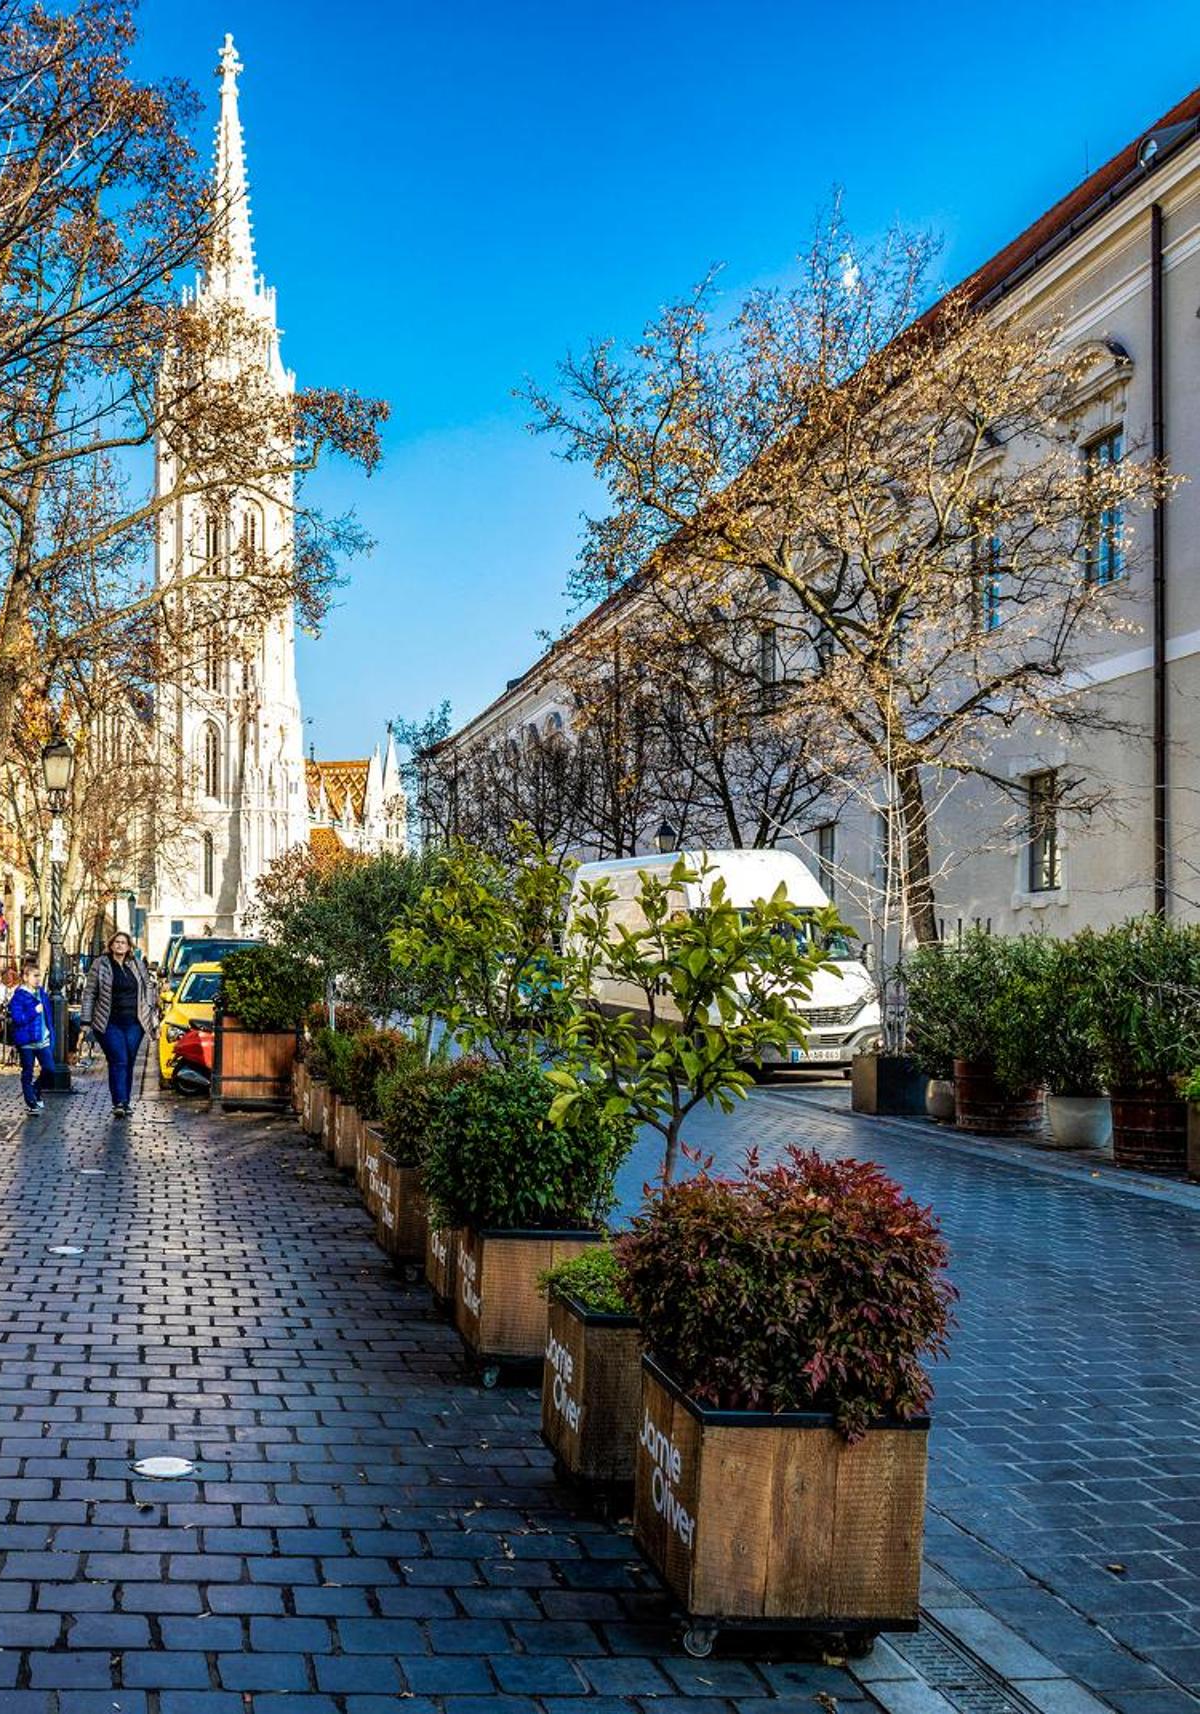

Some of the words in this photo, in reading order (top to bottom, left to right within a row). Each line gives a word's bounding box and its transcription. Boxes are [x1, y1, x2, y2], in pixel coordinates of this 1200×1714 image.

[545, 1328, 574, 1384] Jamie
[553, 1374, 582, 1435] Oliver
[639, 1407, 682, 1485] Jamie
[652, 1466, 696, 1550] Oliver
